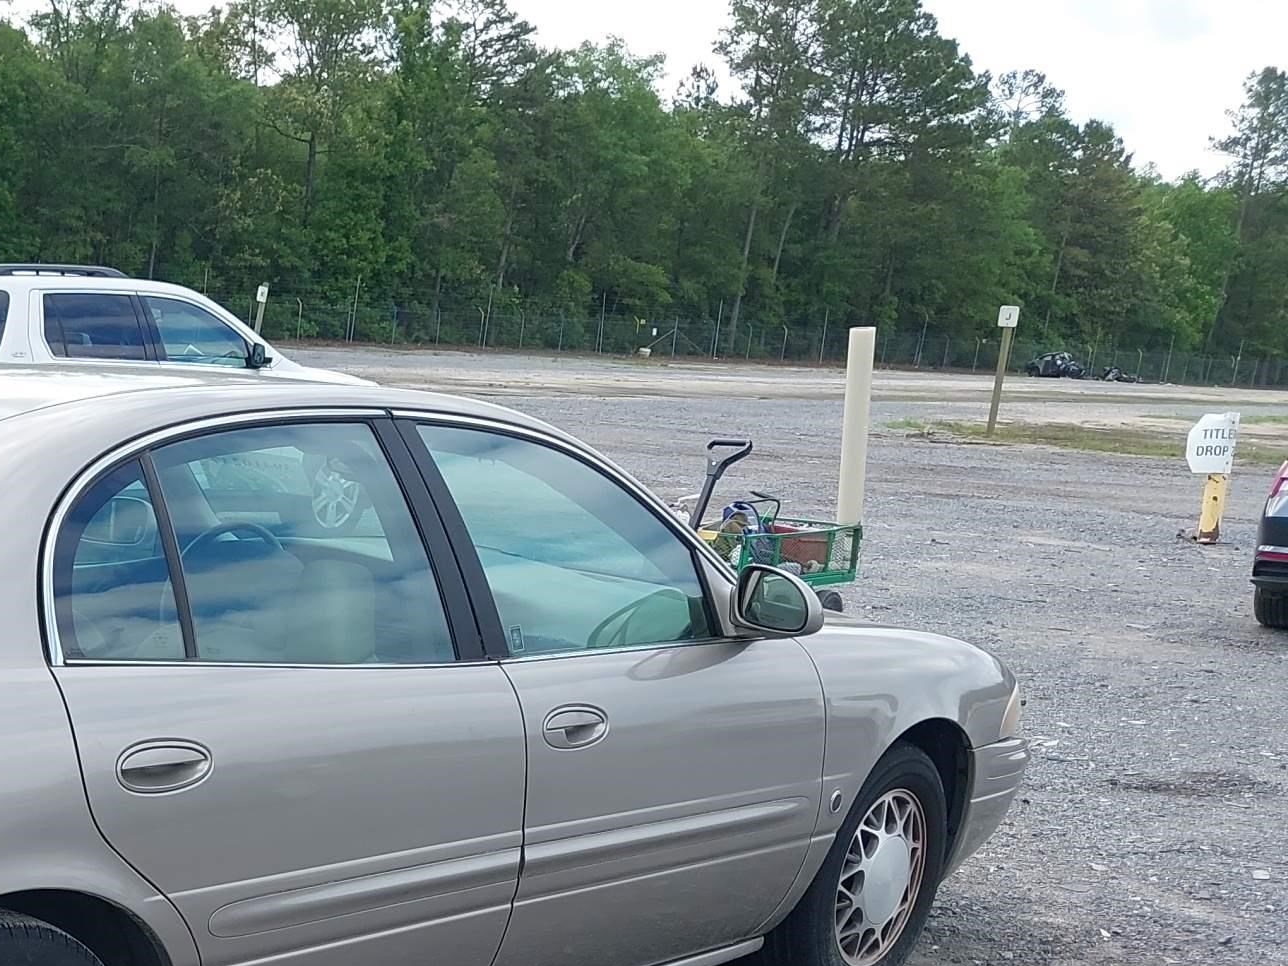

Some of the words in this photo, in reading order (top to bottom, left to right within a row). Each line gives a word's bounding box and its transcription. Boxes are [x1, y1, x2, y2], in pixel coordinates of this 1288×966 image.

[1005, 312, 1012, 321] J
[1202, 428, 1236, 440] TITLE
[1196, 445, 1229, 457] DROP
